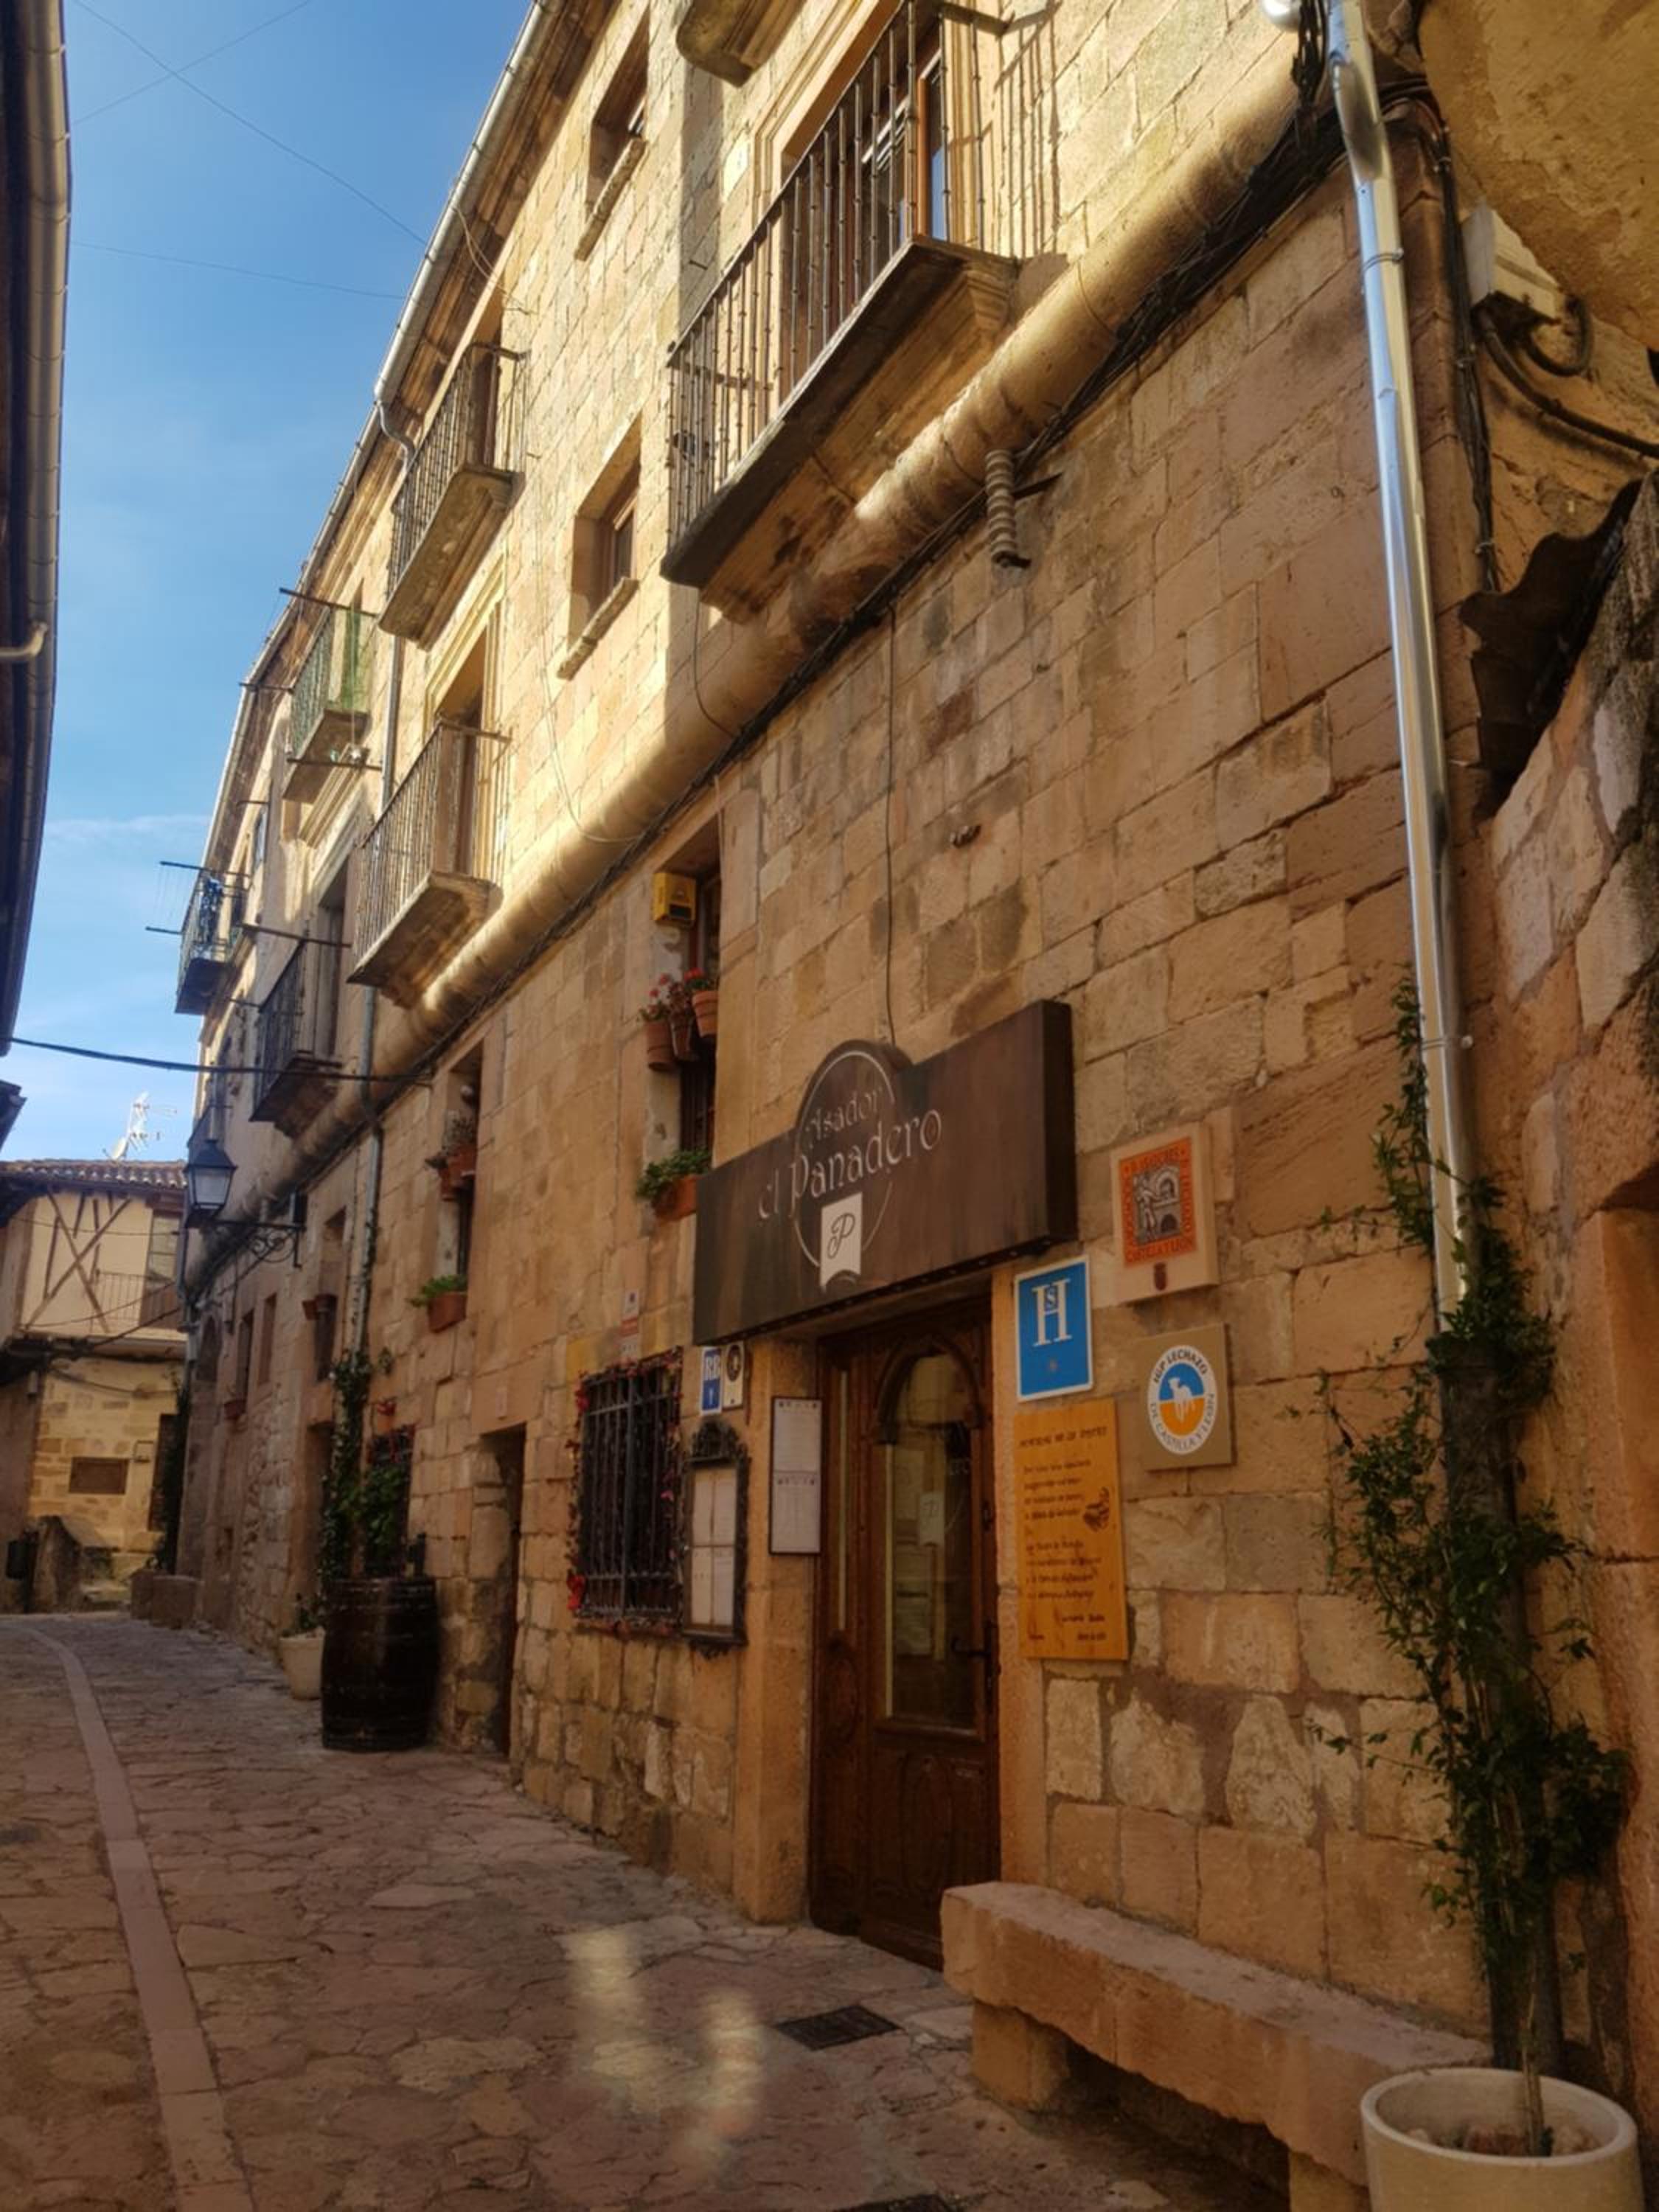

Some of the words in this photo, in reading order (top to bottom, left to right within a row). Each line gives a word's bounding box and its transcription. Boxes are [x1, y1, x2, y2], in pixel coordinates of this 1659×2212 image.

[804, 1087, 884, 1141] Asador
[787, 1108, 942, 1220] Panadero
[827, 1212, 856, 1260] P
